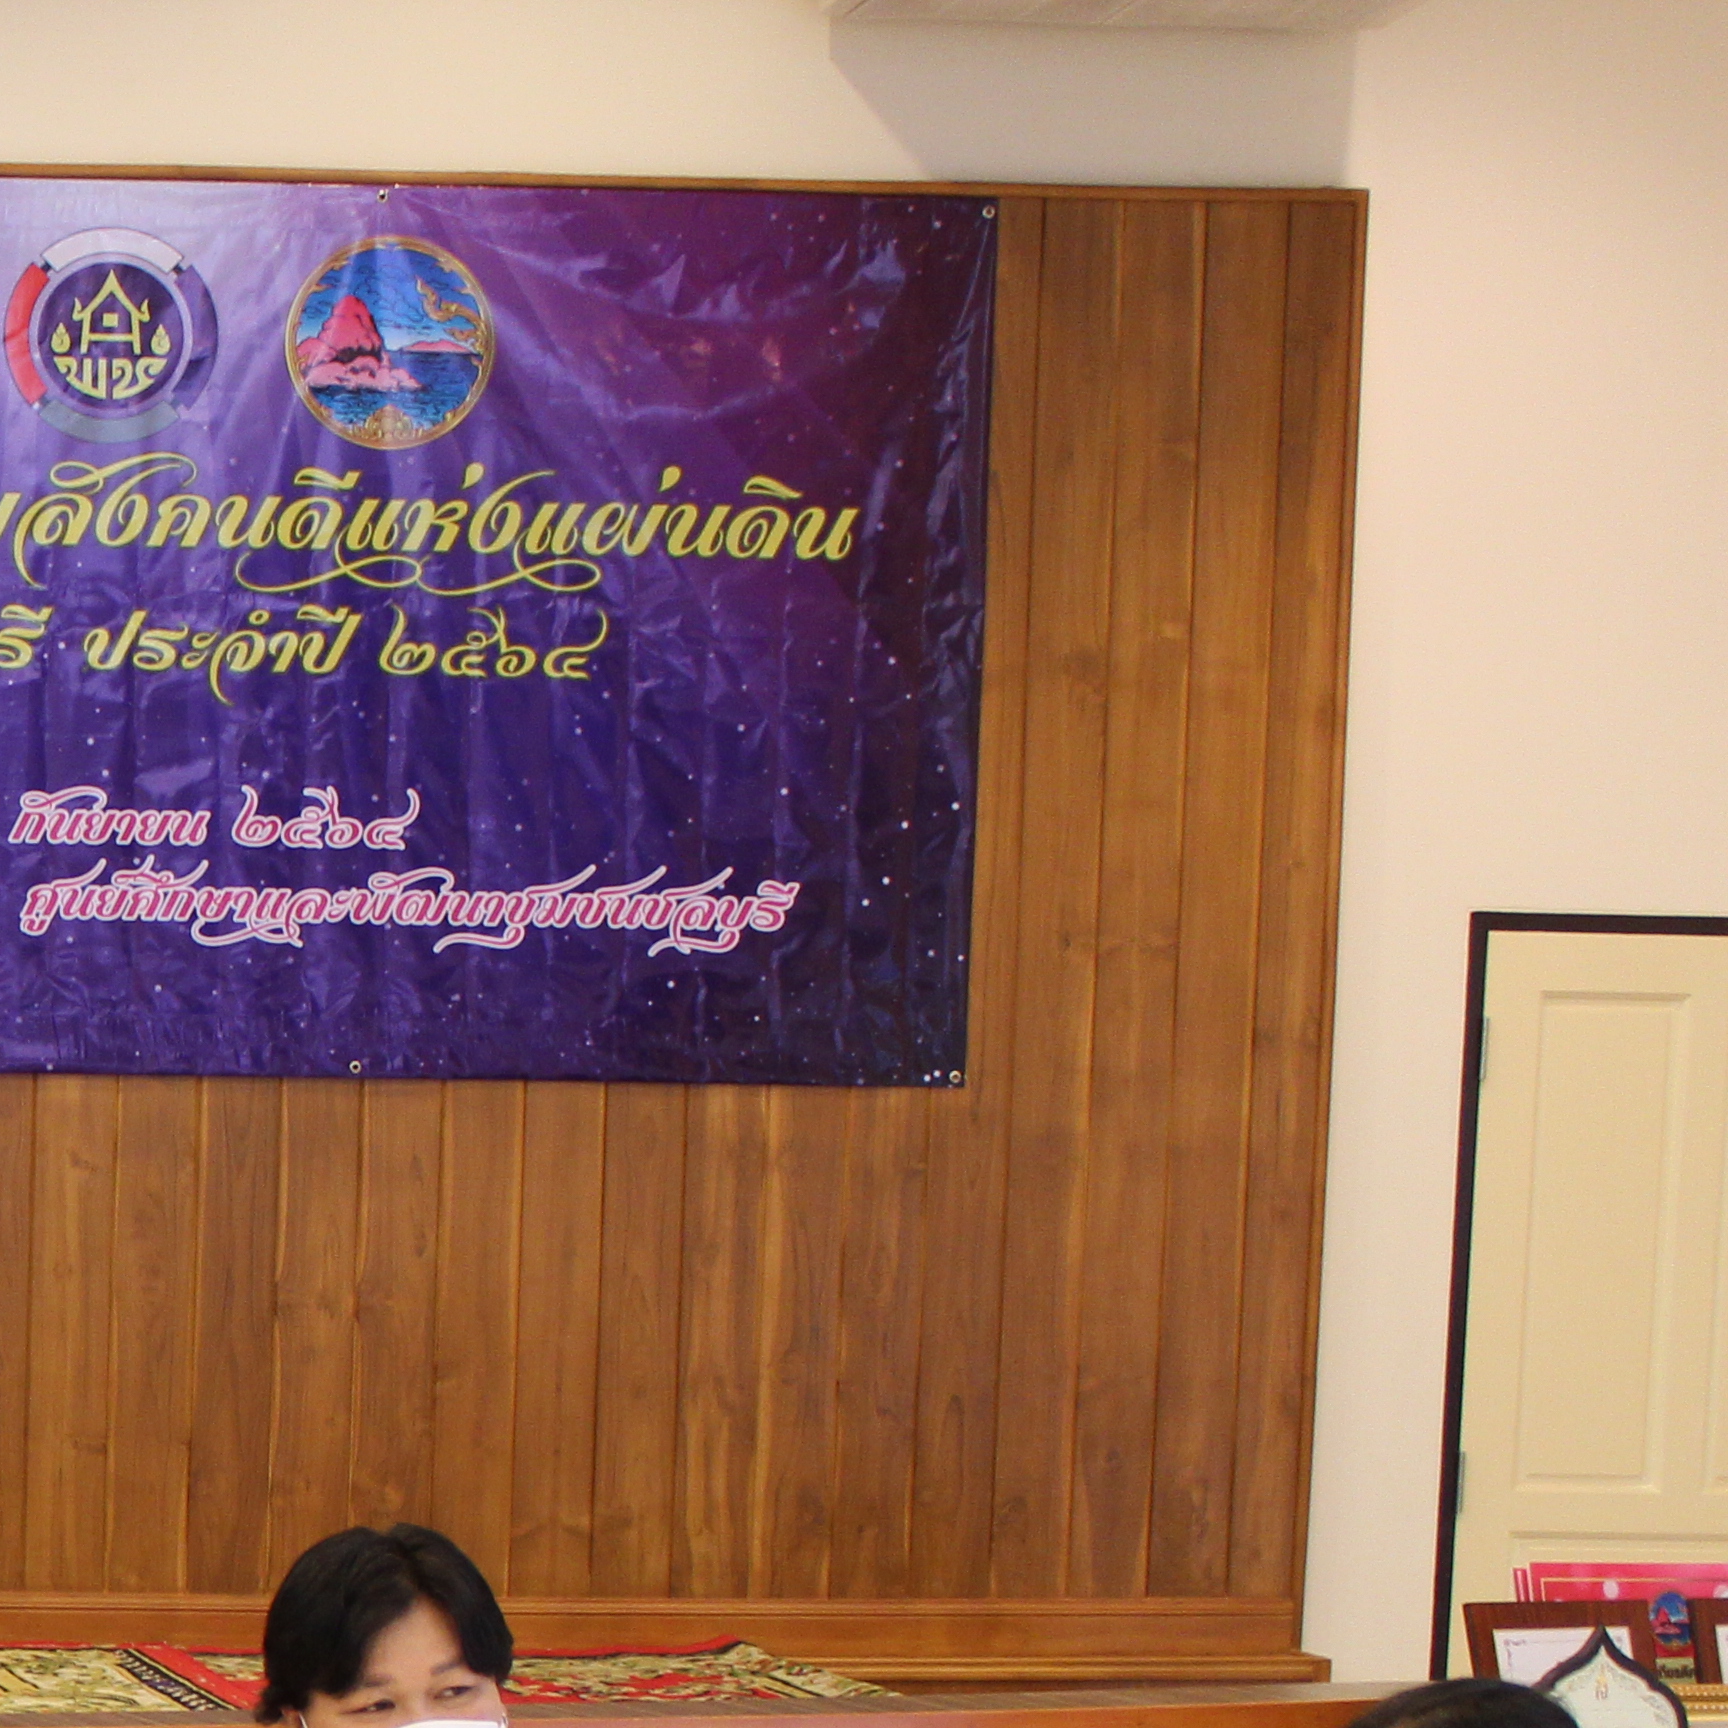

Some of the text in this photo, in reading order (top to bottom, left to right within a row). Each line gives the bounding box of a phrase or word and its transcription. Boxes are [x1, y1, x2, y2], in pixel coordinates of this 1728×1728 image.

[82, 604, 363, 705] ประจำปี
[377, 604, 608, 681] ๒๕๖๔
[8, 786, 211, 846] กันยายน
[230, 784, 422, 850] ๒๕๖๔
[19, 854, 802, 957] ศูนย์ศึกษาและพัฒนาชุมชนชลบุรี
